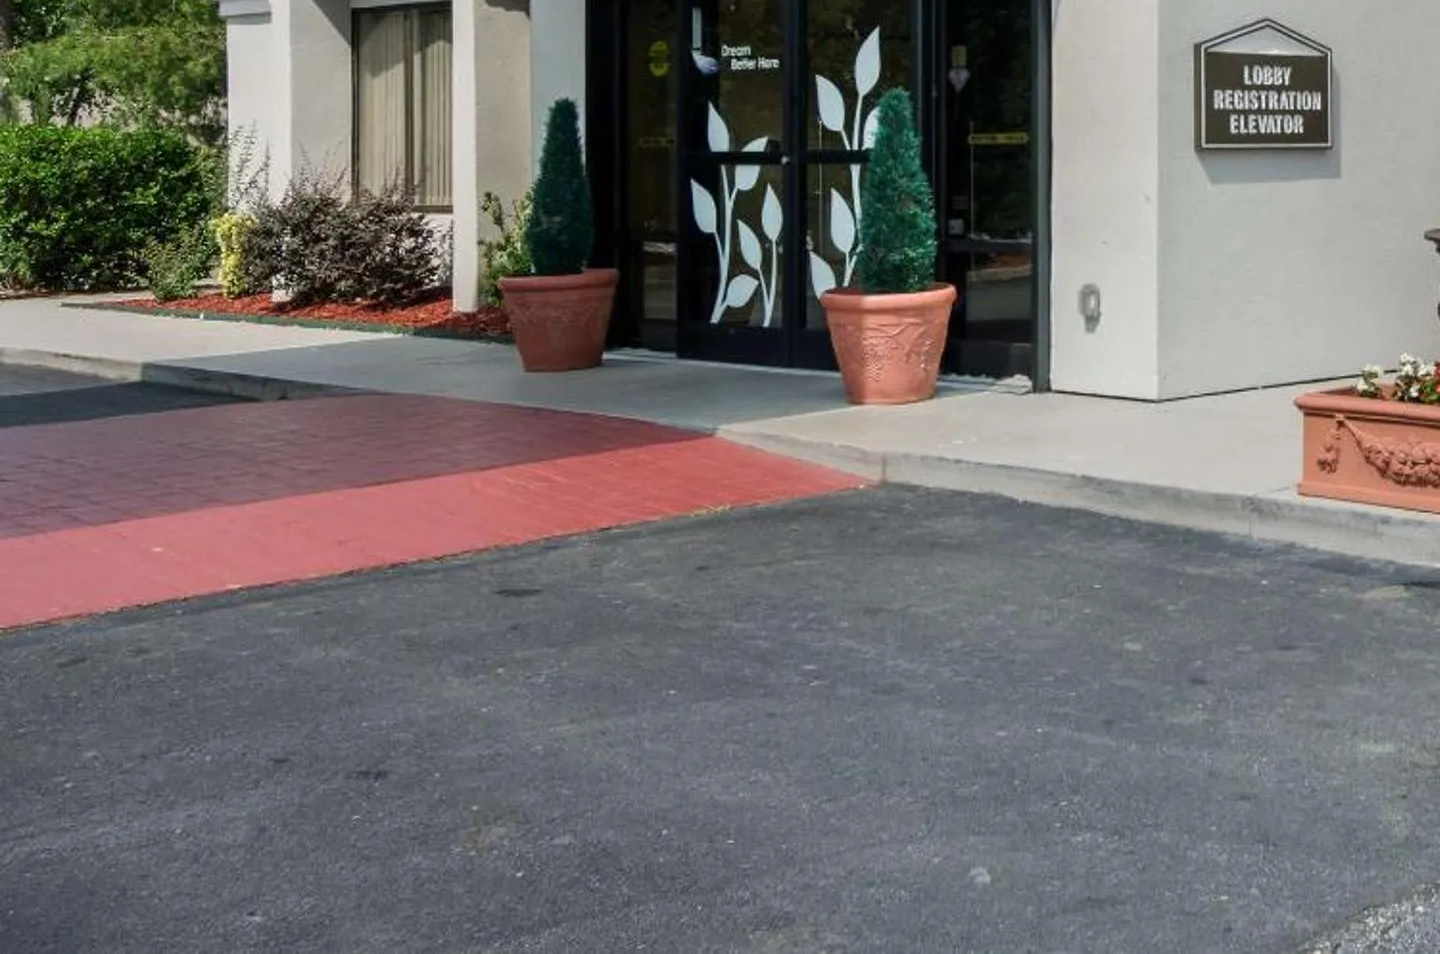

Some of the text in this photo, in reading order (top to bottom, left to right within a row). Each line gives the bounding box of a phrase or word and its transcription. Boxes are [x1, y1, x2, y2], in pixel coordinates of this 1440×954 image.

[721, 44, 752, 57] Dream
[1243, 65, 1292, 86] LOBBY
[1213, 89, 1322, 111] REGISTRATION
[1229, 114, 1305, 135] ELEVATOR
